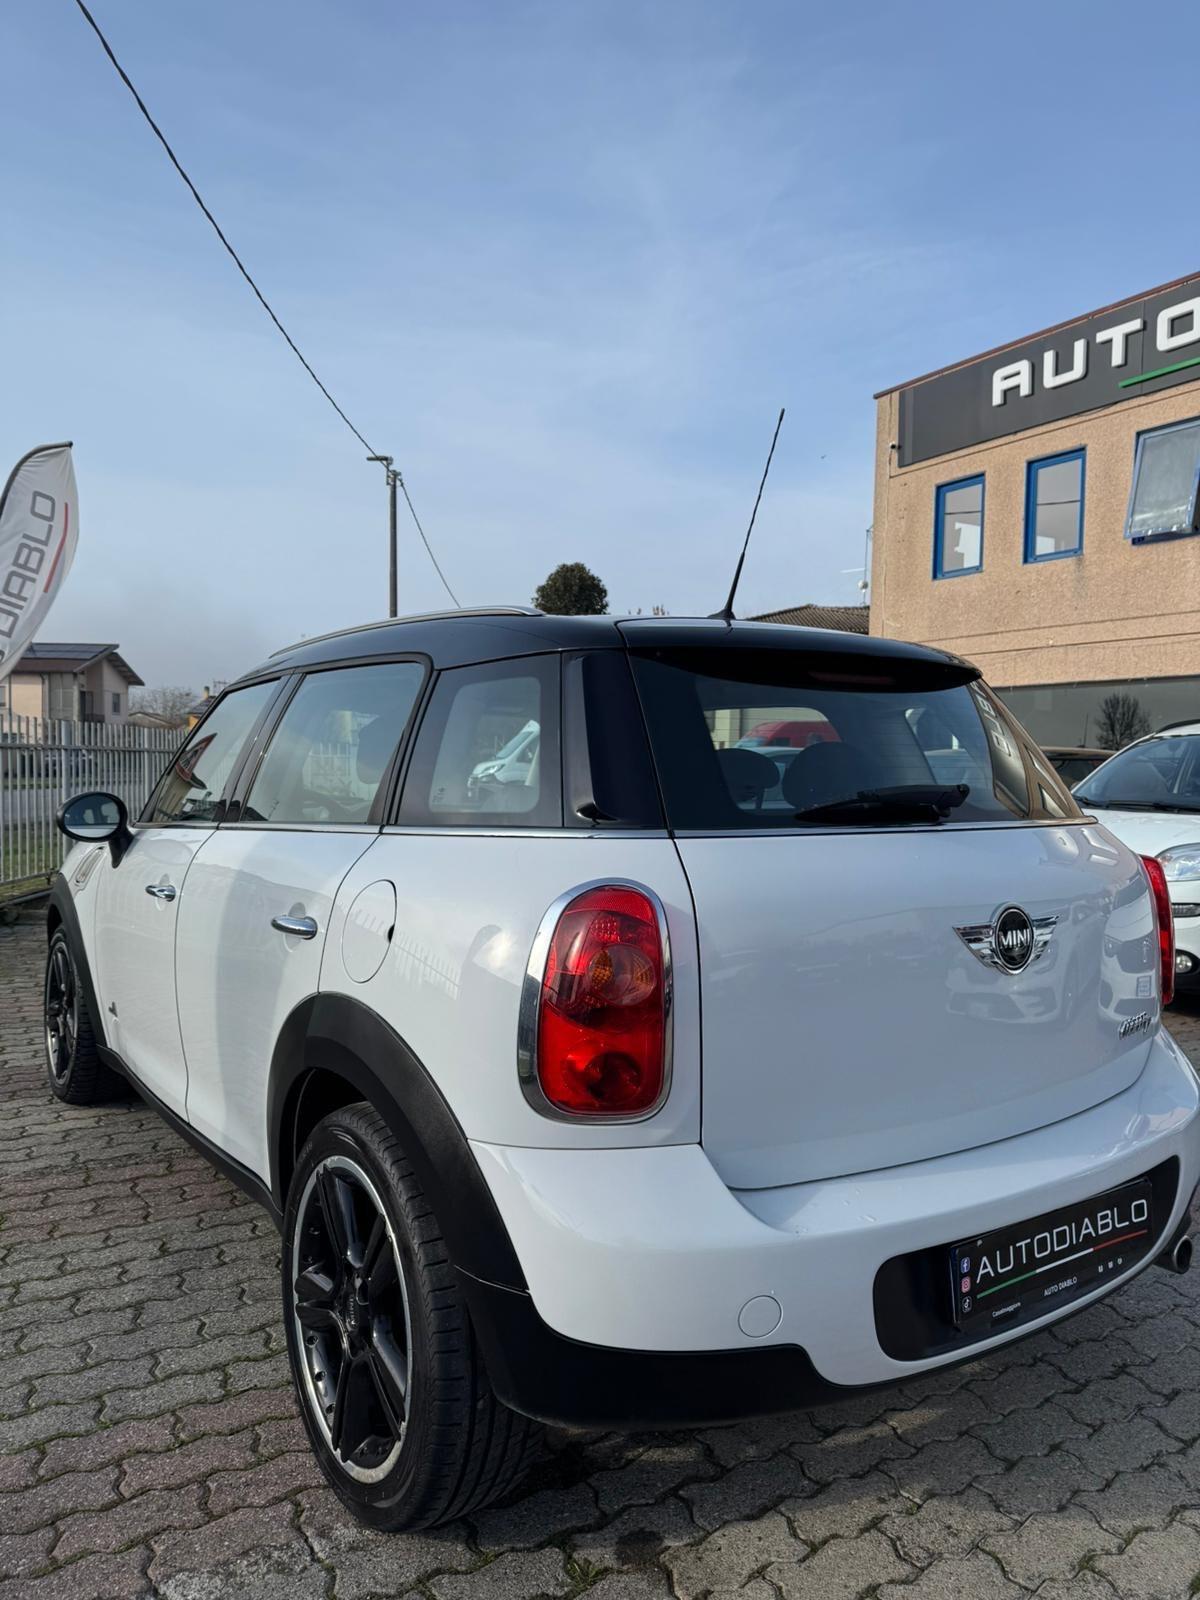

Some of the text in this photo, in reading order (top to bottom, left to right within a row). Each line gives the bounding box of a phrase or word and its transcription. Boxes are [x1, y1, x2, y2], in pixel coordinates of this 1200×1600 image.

[992, 297, 1200, 407] AUTO
[0, 491, 56, 661] DIABLO
[999, 928, 1031, 949] MINI
[976, 1199, 1147, 1284] AUTODIABLO
[1043, 1276, 1078, 1296] AUTO DIABLO
